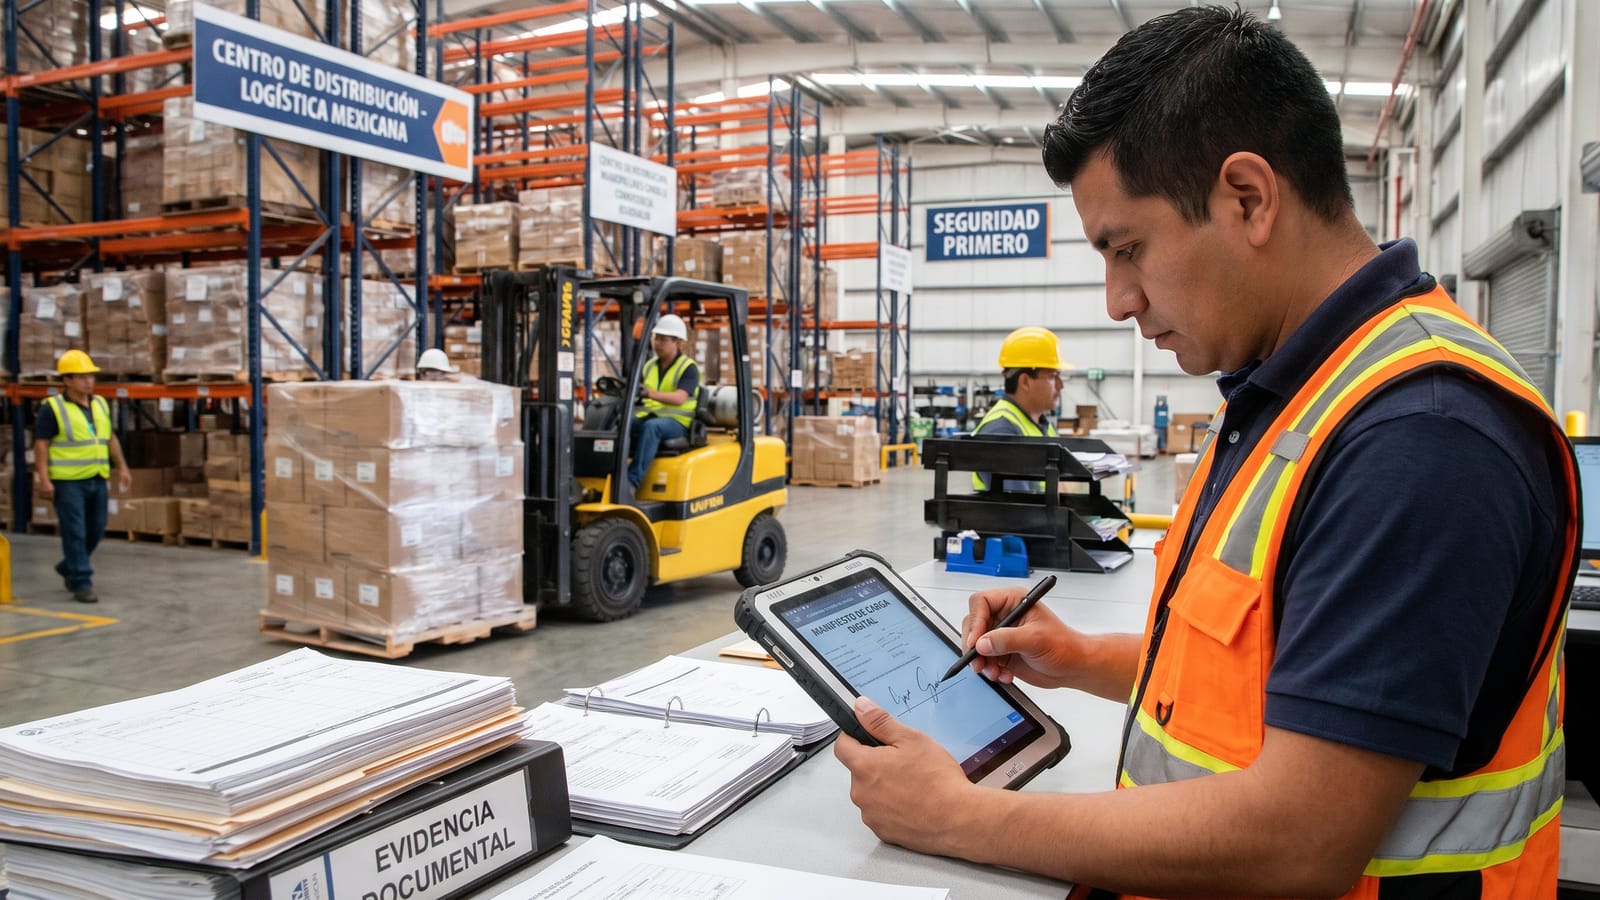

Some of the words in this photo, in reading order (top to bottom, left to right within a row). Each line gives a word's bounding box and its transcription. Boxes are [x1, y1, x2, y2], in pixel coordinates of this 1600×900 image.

[212, 38, 286, 80] CENTRO
[288, 60, 311, 88] DE
[314, 68, 418, 119] DISTRIBUCIÓN
[240, 77, 328, 122] LOGÍSTICA
[331, 102, 408, 143] MEXICANA
[933, 208, 1040, 234] SEGURIDAD
[943, 232, 1029, 256] PRIMERO
[811, 612, 854, 637] MANIFIESTO
[854, 607, 868, 618] DE
[865, 599, 891, 613] CARGA
[847, 617, 879, 634] DIGITAL
[375, 799, 495, 873] EVIDENCIA
